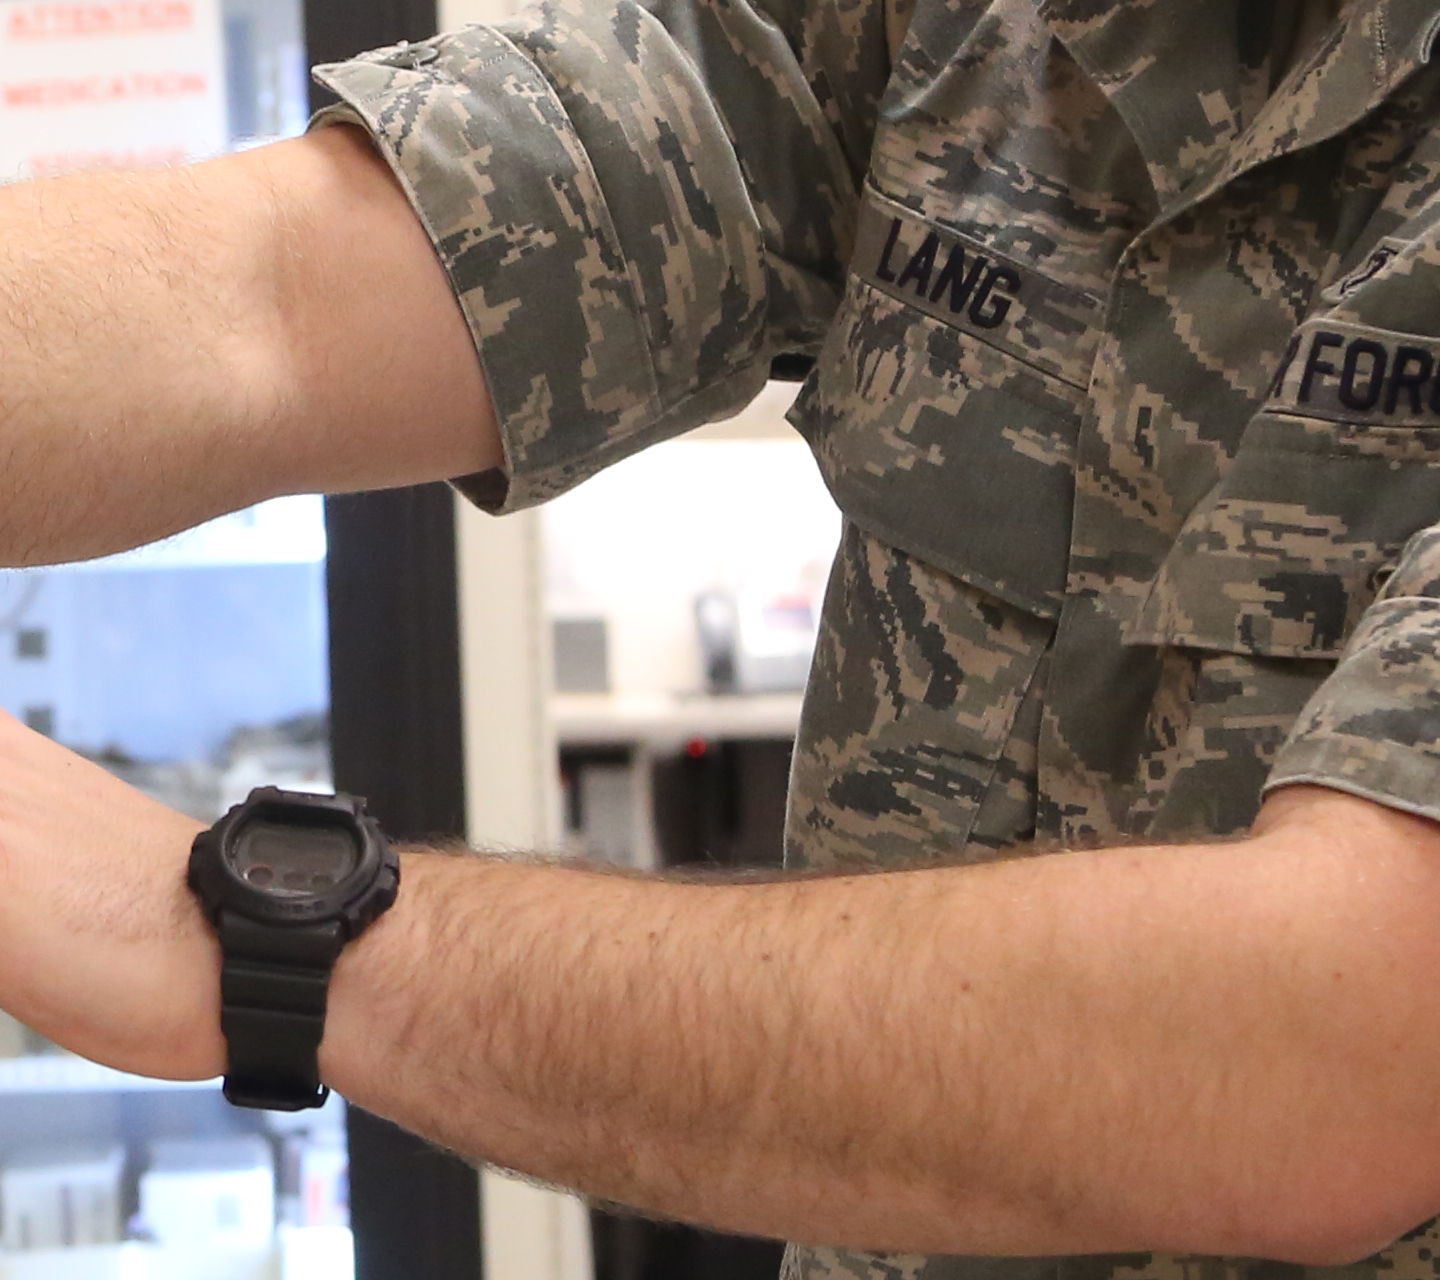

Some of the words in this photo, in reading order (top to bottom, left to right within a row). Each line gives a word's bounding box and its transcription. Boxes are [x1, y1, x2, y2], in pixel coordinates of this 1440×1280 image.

[8, 0, 193, 38] ATTENTION
[2, 73, 206, 108] MEDICATION
[876, 216, 1021, 329] LANG
